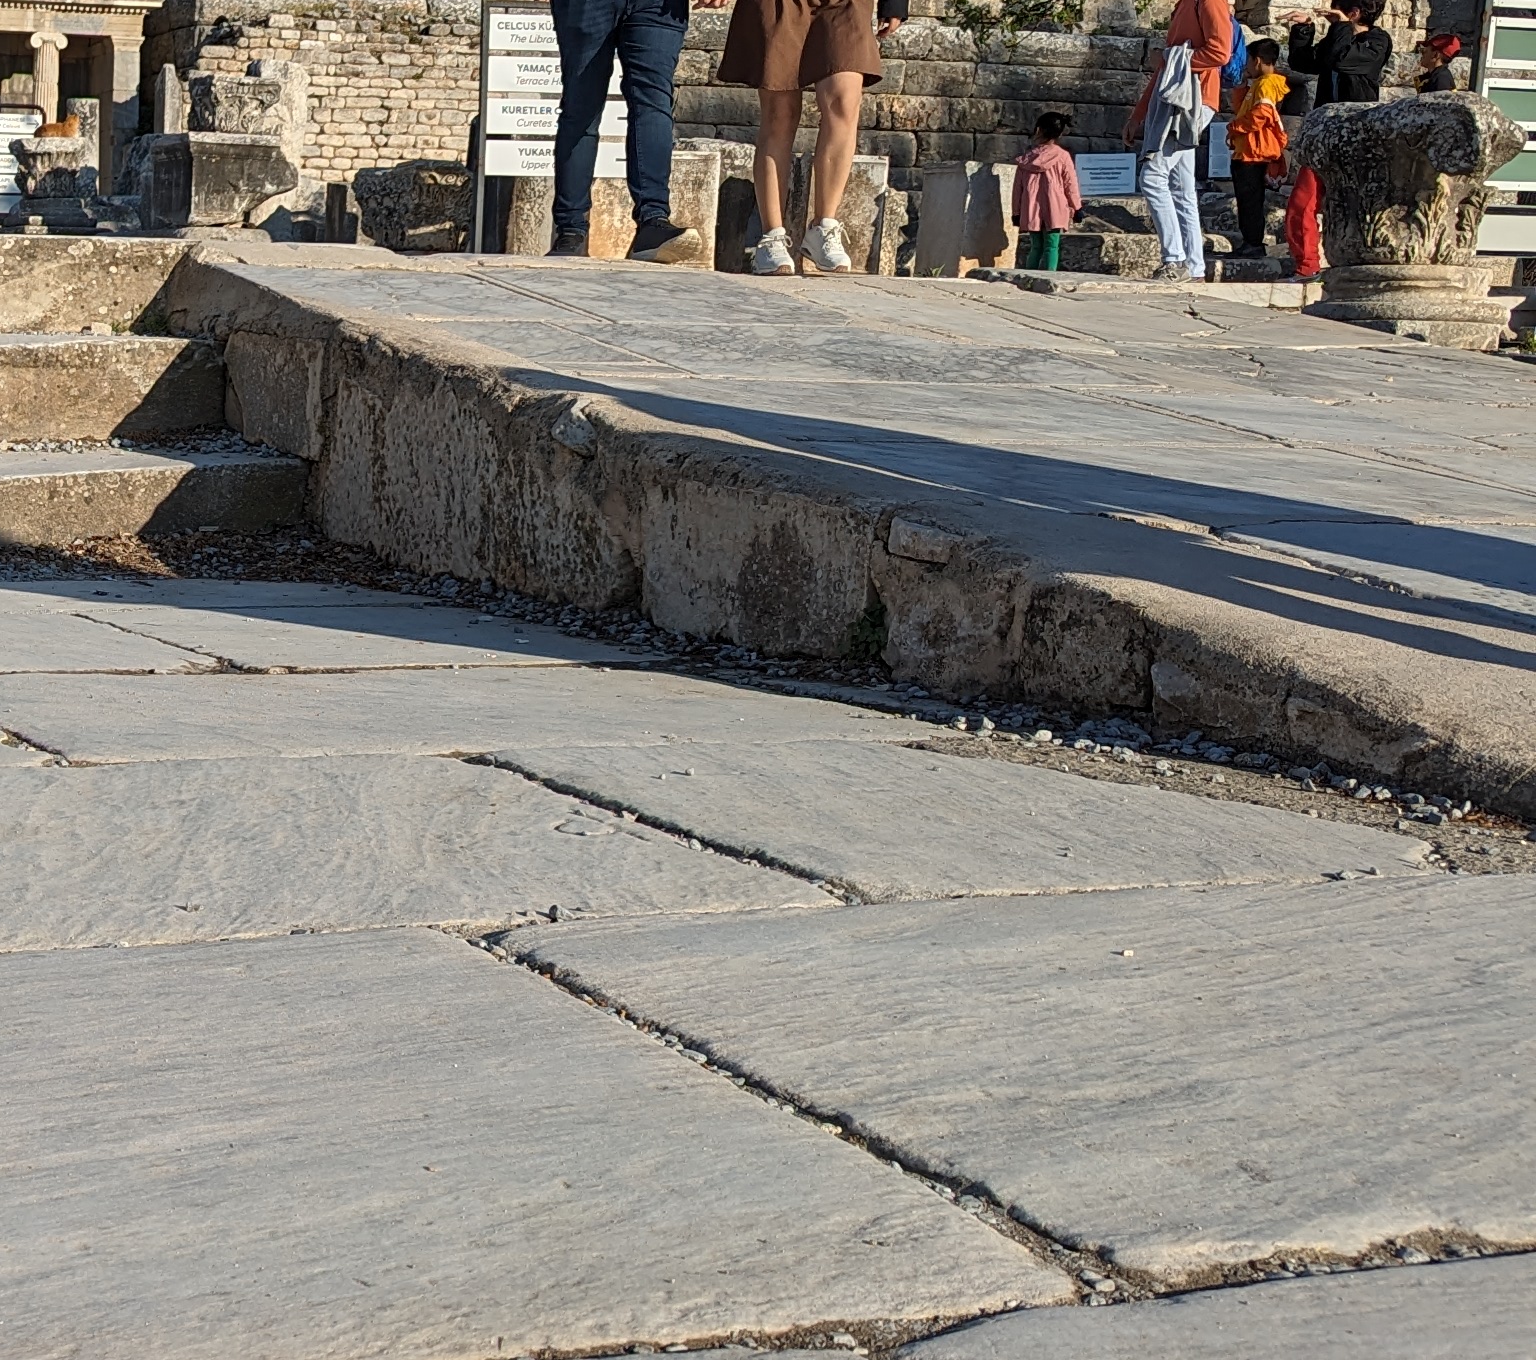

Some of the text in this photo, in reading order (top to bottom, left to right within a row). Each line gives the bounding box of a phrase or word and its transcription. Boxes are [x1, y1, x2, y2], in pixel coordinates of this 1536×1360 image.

[497, 21, 536, 31] CELCUS
[510, 33, 527, 43] The
[516, 64, 553, 75] YAMAÇ
[516, 76, 550, 86] Terrace
[501, 105, 552, 115] KURETLER
[516, 118, 553, 128] Curetes
[520, 160, 551, 171] Upper
